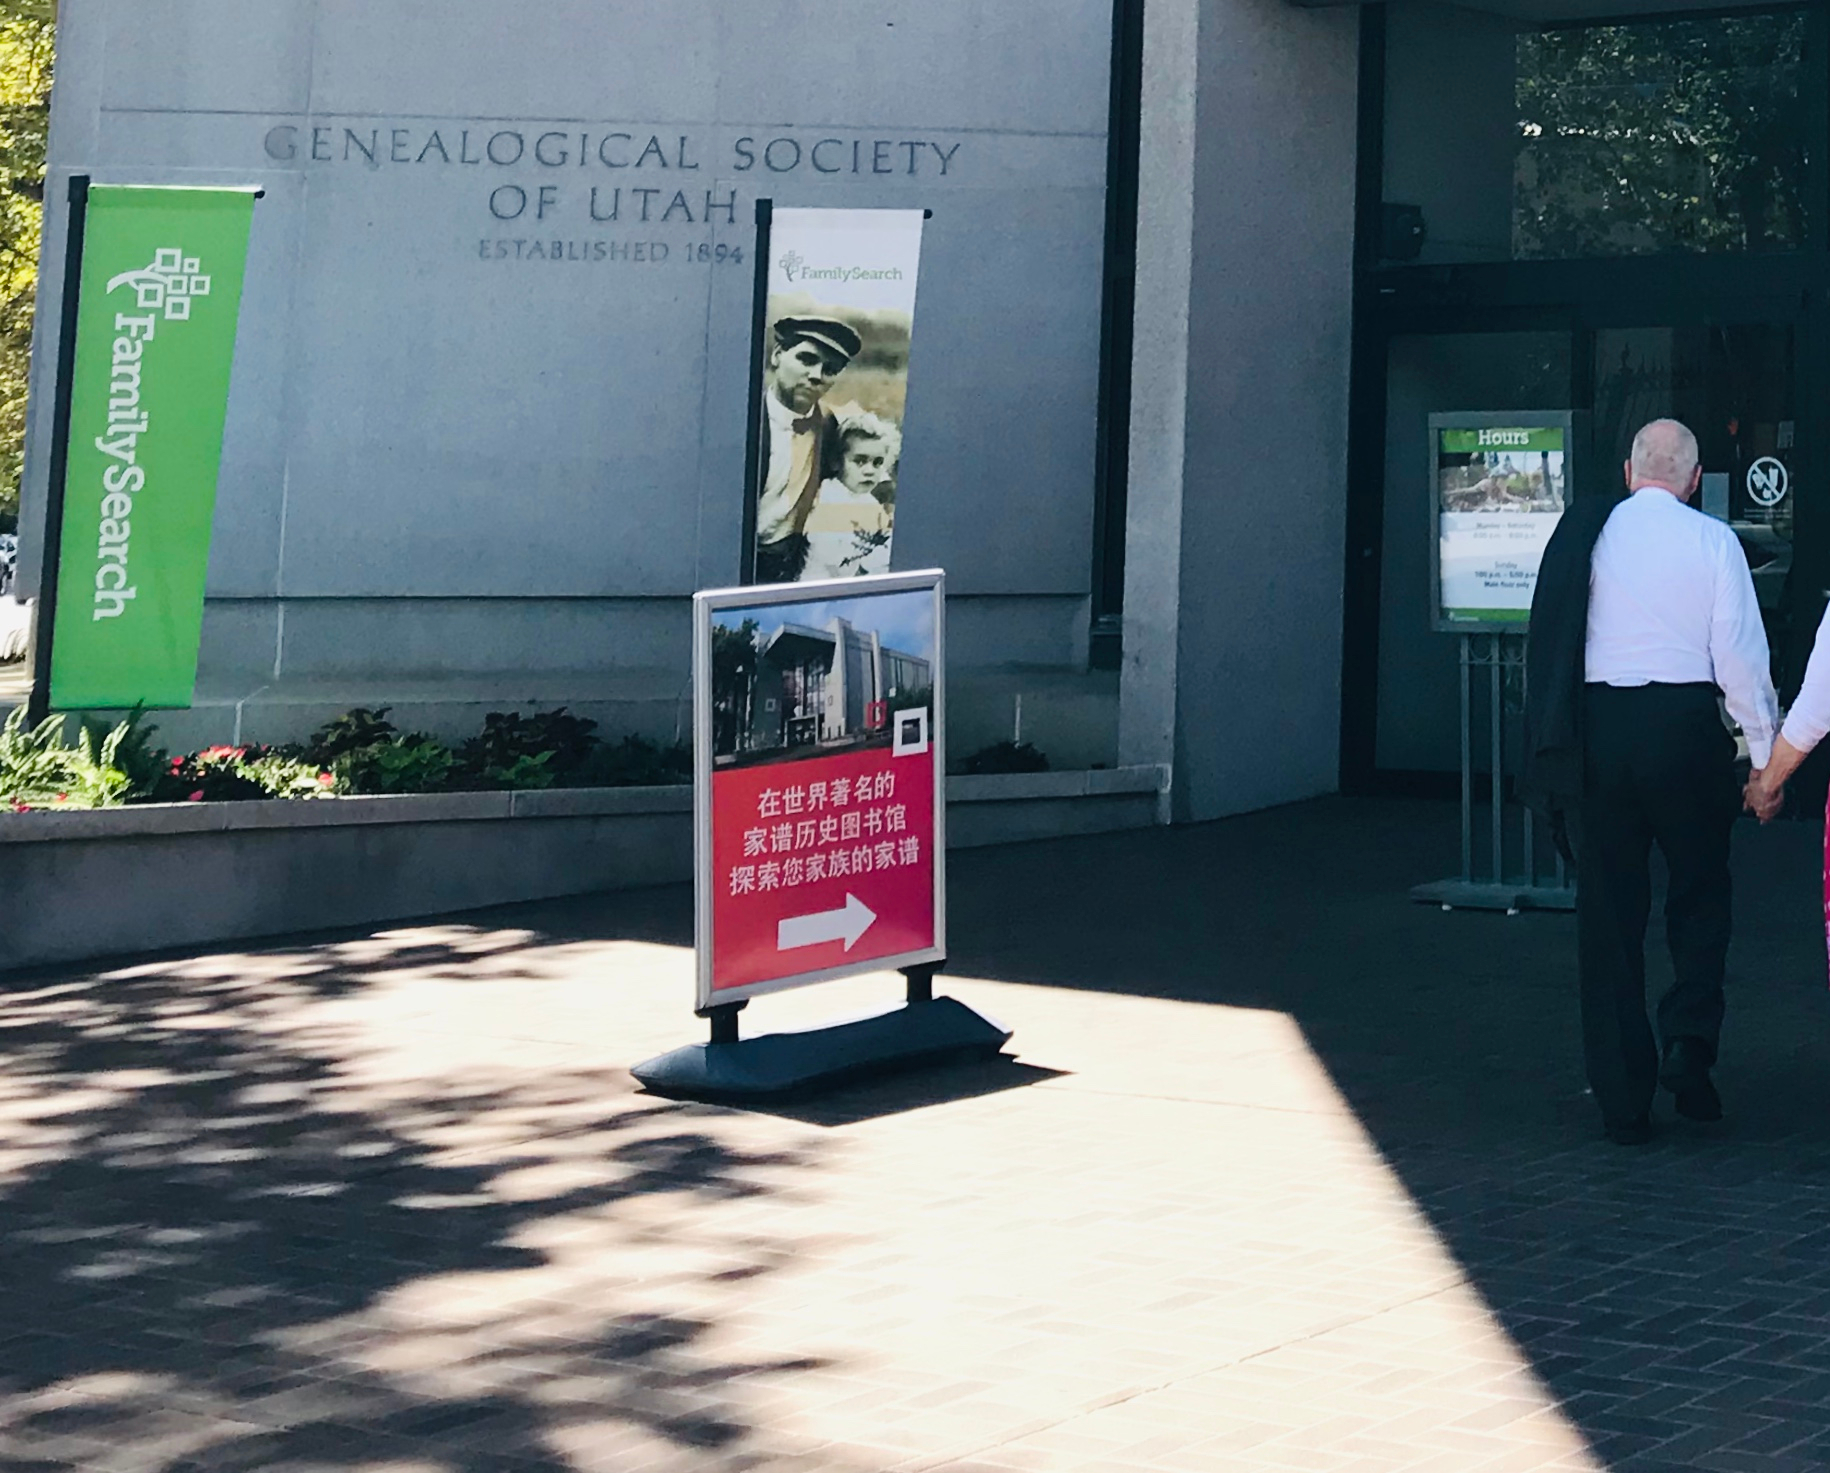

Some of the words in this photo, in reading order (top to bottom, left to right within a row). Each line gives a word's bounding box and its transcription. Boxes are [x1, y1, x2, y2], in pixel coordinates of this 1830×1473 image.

[263, 125, 699, 172] GENEALOGICAL
[734, 137, 962, 176] SOCIETY
[490, 183, 557, 223] OF
[589, 187, 739, 224] UTAH
[479, 239, 669, 262] ESTABLISHED
[685, 242, 743, 264] 1894
[801, 266, 903, 283] FamilySearch
[1478, 430, 1529, 446] Hours
[92, 312, 155, 621] FamilySearch
[757, 771, 895, 819] 在世界著名的
[743, 804, 907, 857] 家谱历史图书馆
[729, 837, 920, 897] 探索您家族的家谱
